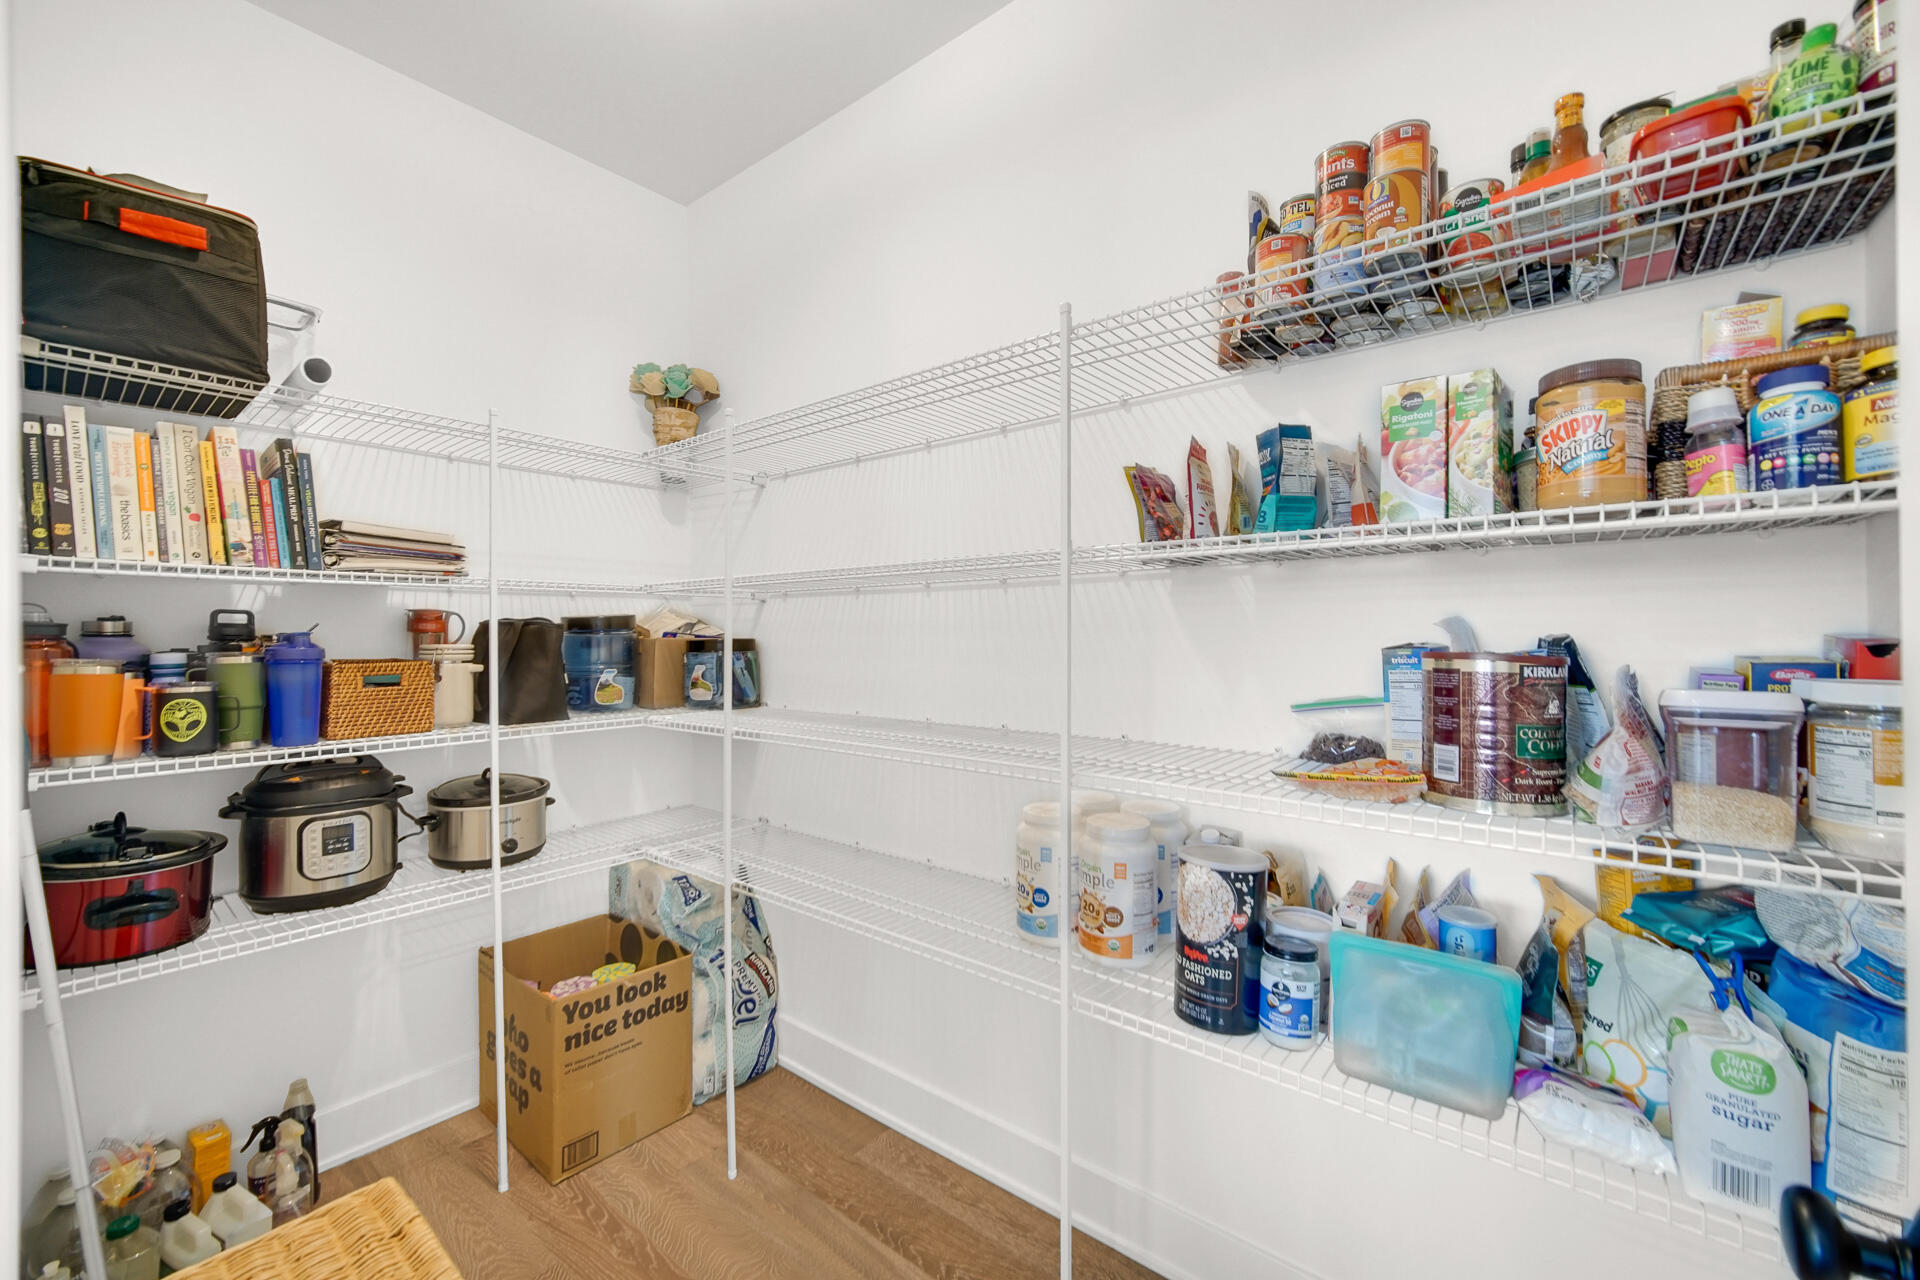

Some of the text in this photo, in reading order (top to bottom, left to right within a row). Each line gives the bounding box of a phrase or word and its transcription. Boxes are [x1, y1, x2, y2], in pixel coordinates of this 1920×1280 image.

[1791, 55, 1829, 80] LIME
[1793, 72, 1823, 90] JUICE
[1365, 201, 1394, 219] coconut
[1366, 210, 1391, 226] cream
[1392, 410, 1433, 424] Rigatoni
[1762, 406, 1792, 422] ONE
[1811, 402, 1836, 414] DAY
[183, 437, 193, 453] Can
[1541, 414, 1604, 455] SKIPPY
[71, 420, 85, 483] LOVE real FOOD
[1548, 428, 1615, 473] Natural
[183, 454, 195, 477] Cook
[53, 487, 70, 504] 101
[184, 478, 196, 505] Vegan
[305, 489, 313, 506] VEGAN
[120, 500, 131, 541] the basics
[307, 507, 315, 527] INSTANT
[1391, 655, 1419, 665] triscuit
[1774, 671, 1812, 679] Barilla
[1083, 900, 1095, 914] 20
[747, 952, 776, 996] KIRKLAND
[1182, 958, 1232, 981] FASHIONED
[1184, 970, 1206, 986] OATS
[562, 971, 667, 1025] You look
[564, 990, 689, 1052] nice today
[1723, 1051, 1764, 1073] THAT'S
[530, 1066, 542, 1093] a
[1705, 1092, 1782, 1121] GRANULATED
[1728, 1092, 1757, 1107] PURE
[1712, 1105, 1775, 1132] sugar
